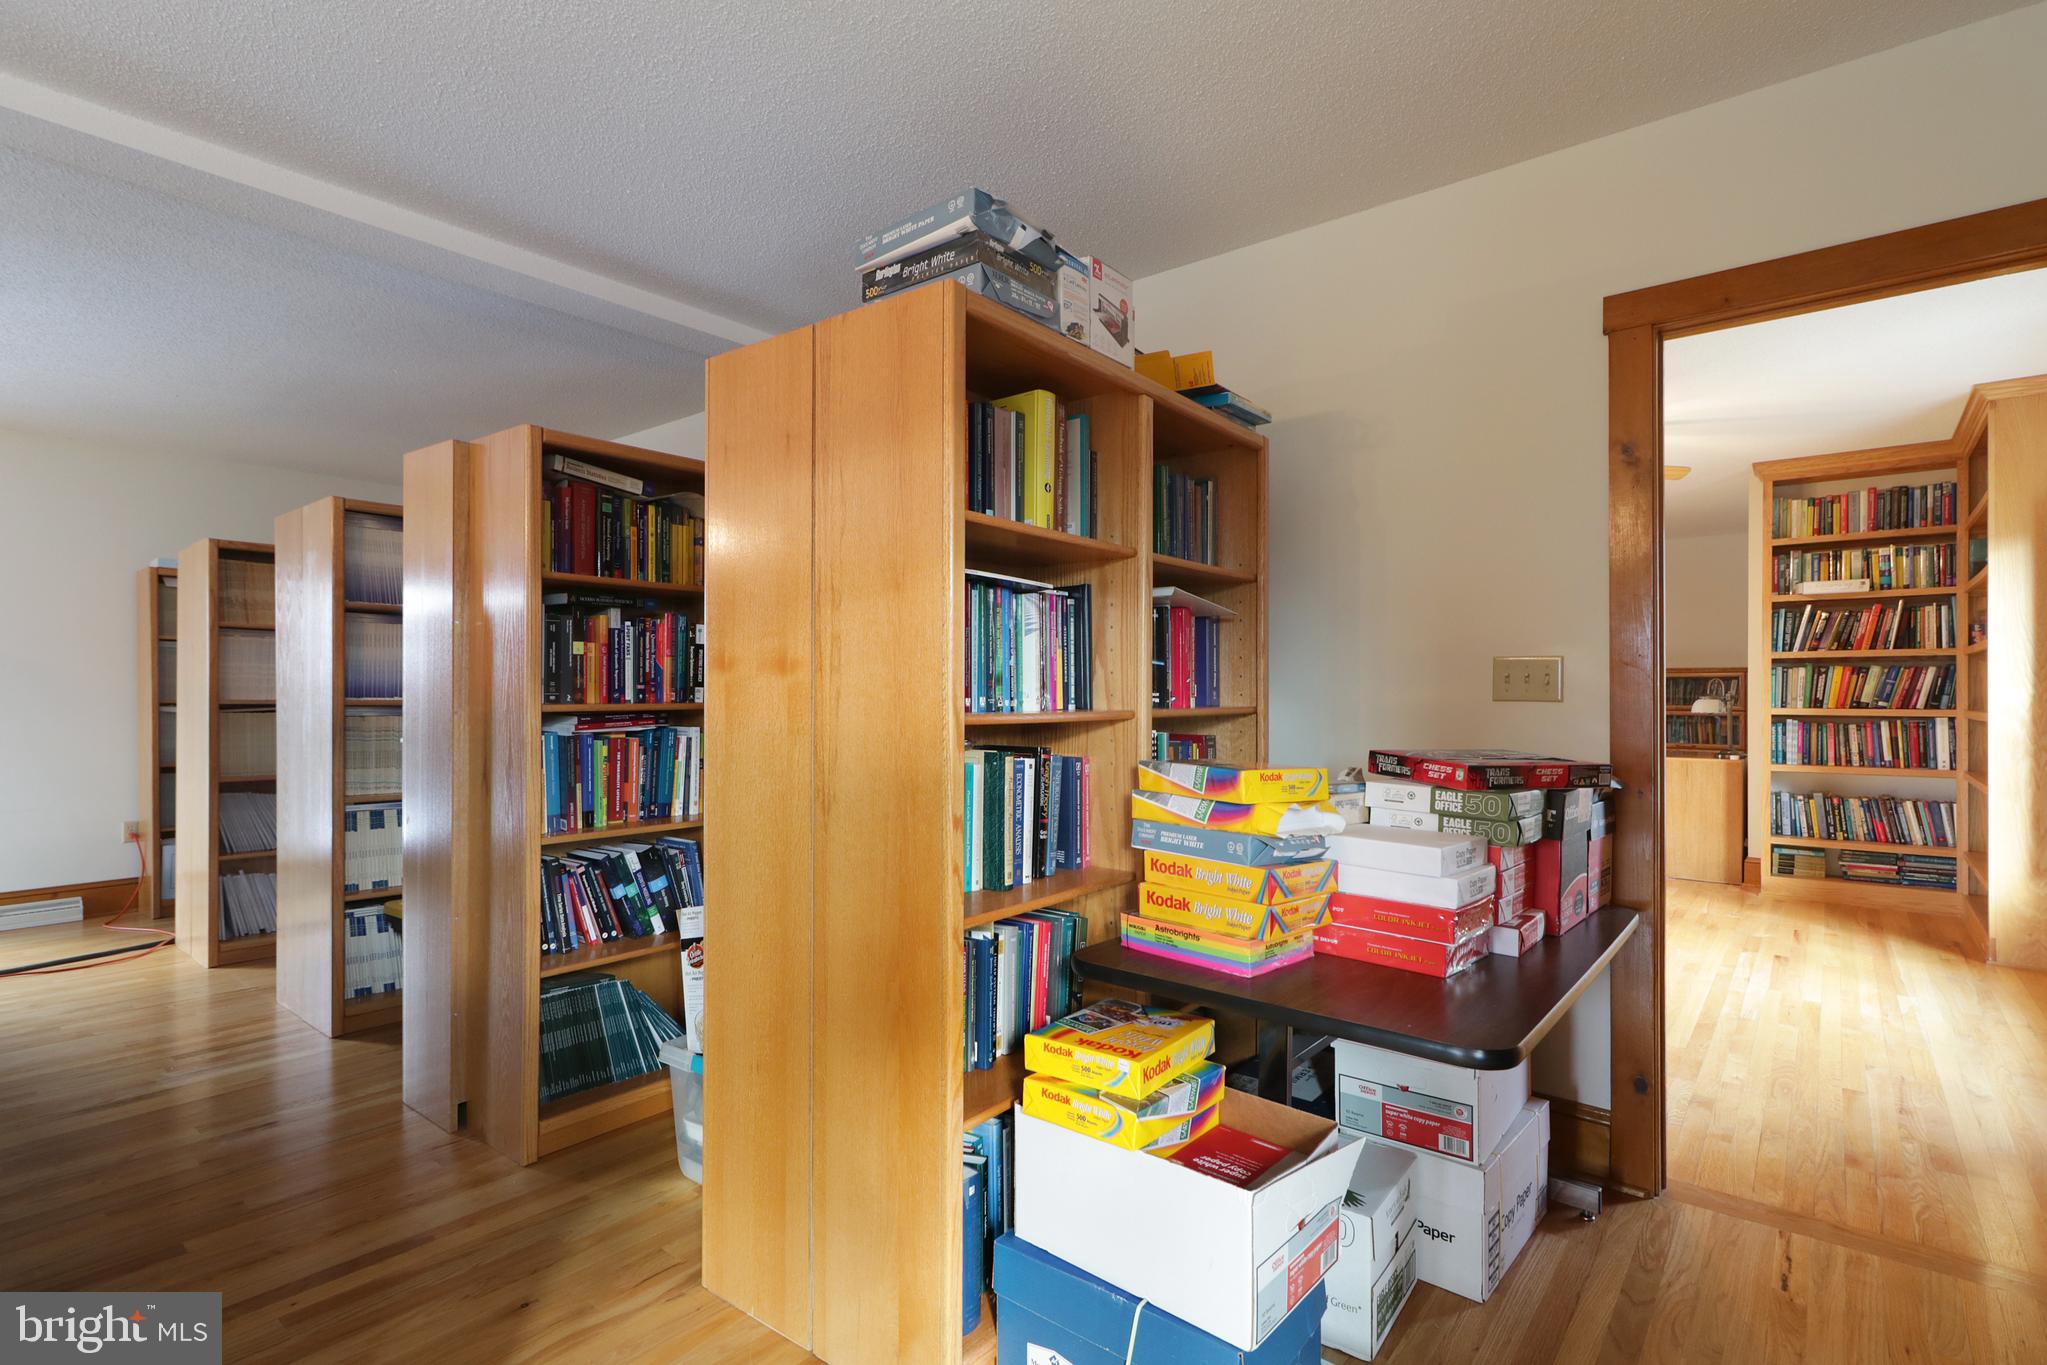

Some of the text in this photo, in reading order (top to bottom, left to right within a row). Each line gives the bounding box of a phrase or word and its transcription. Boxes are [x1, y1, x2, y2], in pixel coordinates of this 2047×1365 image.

[903, 251, 955, 277] Bright White
[1030, 262, 1041, 275] 500
[866, 287, 877, 299] 500
[1378, 762, 1411, 776] FORMERS
[1423, 763, 1453, 773] CHESS
[1428, 770, 1446, 780] SET
[1536, 768, 1564, 776] CHESS
[1260, 772, 1283, 782] Kodak
[1541, 774, 1558, 782] SET
[1435, 790, 1463, 802] EAGLE
[1435, 801, 1463, 812] OFFICE
[1464, 794, 1501, 816] 50
[1015, 774, 1024, 855] ECONOMETRIC ANALYSIS
[1443, 817, 1471, 828] EAGLE
[1473, 820, 1511, 843] 50
[1160, 836, 1204, 849] BRIGHT WHITE
[1150, 857, 1253, 888] Kodak Bright White
[1282, 869, 1301, 880] Kodak
[1146, 890, 1253, 925] Kodak Bright White
[1281, 906, 1299, 916] Kodak
[1373, 913, 1399, 924] COLOR
[1402, 920, 1431, 929] INKJET
[1154, 924, 1200, 941] Astrobrights
[1264, 939, 1288, 951] Astrobrights
[1366, 947, 1392, 957] COLOR
[1395, 953, 1423, 963] INKJET
[1044, 1042, 1073, 1058] Kodak
[1076, 1038, 1143, 1058] Kodak
[1143, 1056, 1171, 1084] Kodak
[1042, 1088, 1070, 1105] Kodak
[1076, 1114, 1086, 1122] 500
[1400, 1111, 1413, 1120] white
[1414, 1116, 1425, 1124] copy
[1425, 1118, 1440, 1127] paper
[1193, 1158, 1247, 1179] super white
[1200, 1155, 1251, 1176] copy paper
[1516, 1182, 1532, 1214] Paper
